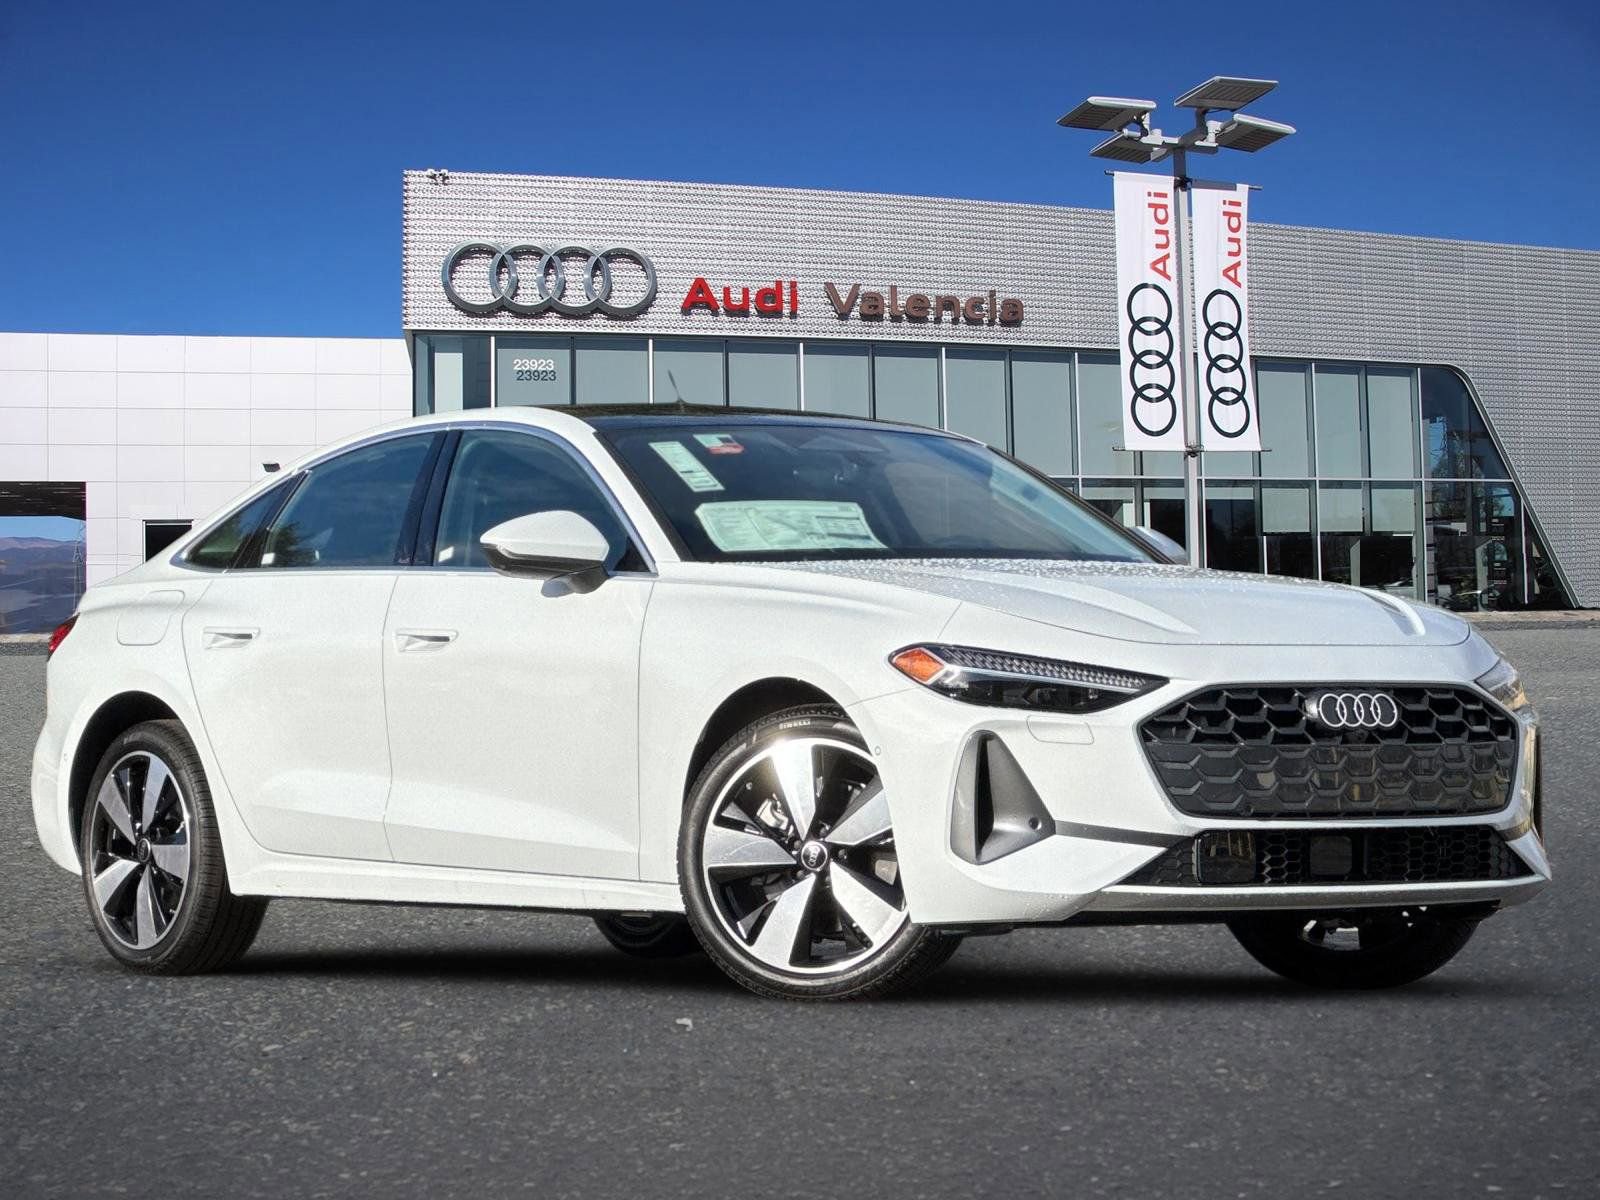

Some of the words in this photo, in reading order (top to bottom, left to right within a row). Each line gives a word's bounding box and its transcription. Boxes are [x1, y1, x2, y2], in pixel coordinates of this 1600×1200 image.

[1147, 191, 1172, 282] Audi
[1222, 199, 1242, 289] Audi
[681, 277, 798, 316] Audi
[824, 281, 1025, 325] Valencia
[513, 358, 554, 370] 23923
[516, 369, 557, 381] 23923
